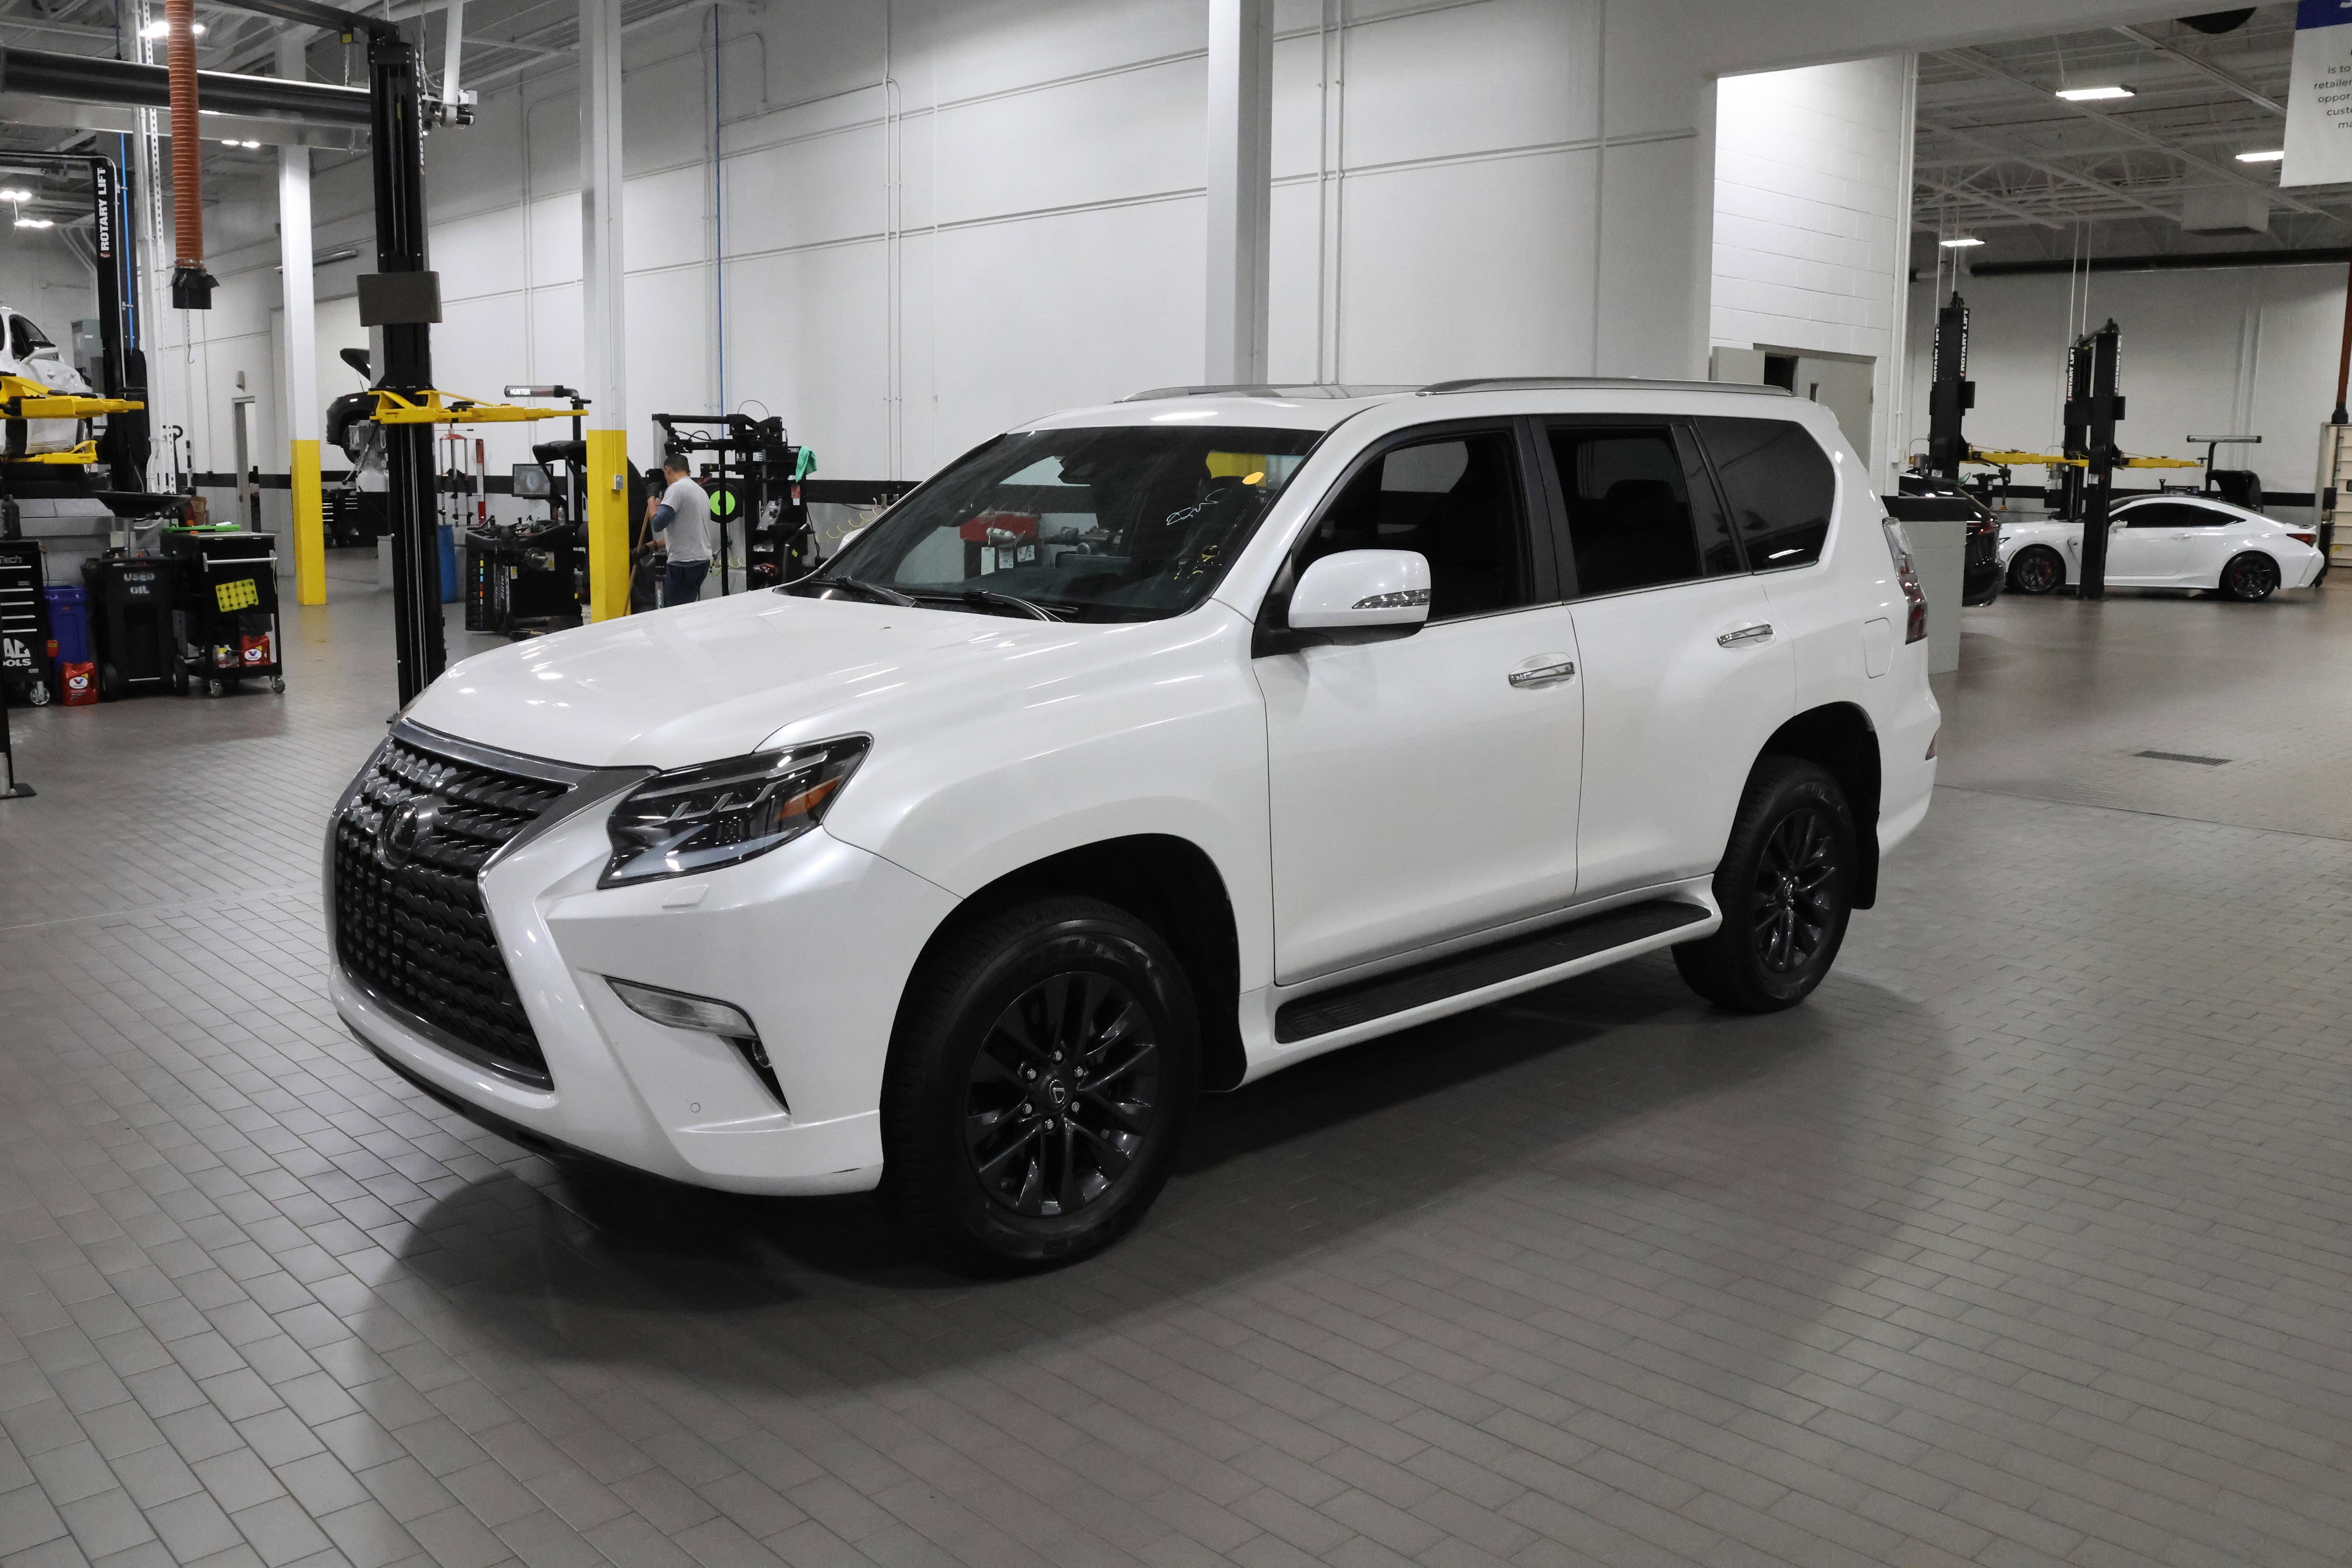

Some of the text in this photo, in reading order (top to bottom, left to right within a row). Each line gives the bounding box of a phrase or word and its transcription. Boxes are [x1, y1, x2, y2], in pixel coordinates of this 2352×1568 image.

[2318, 94, 2352, 103] oppor
[97, 167, 109, 251] ROTARY LIFT
[123, 572, 155, 581] USED
[130, 585, 150, 594] OIL
[3, 638, 31, 658] AC
[3, 658, 31, 666] OLS
